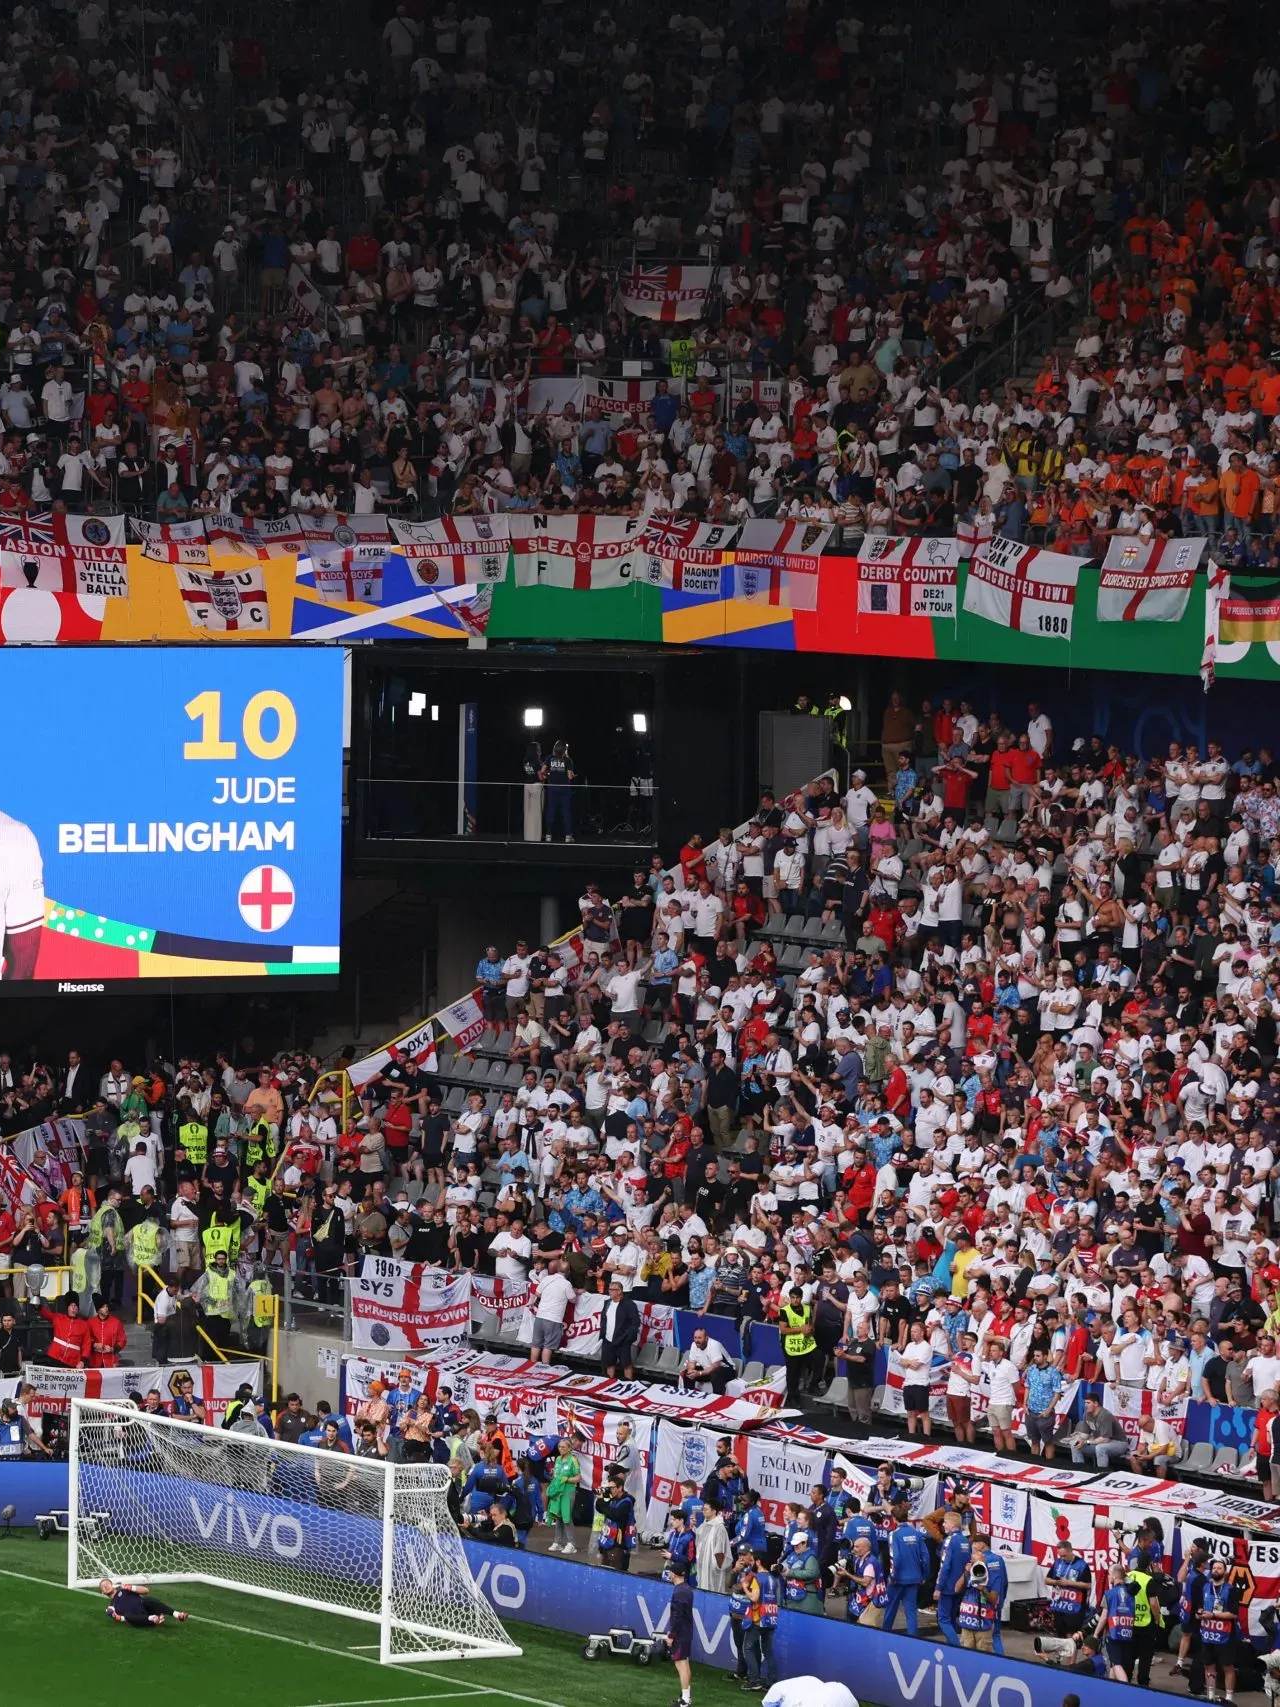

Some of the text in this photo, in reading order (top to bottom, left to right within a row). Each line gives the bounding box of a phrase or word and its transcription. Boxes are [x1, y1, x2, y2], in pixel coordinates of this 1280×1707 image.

[589, 397, 651, 414] MACCLESF
[265, 520, 291, 533] 2024
[534, 514, 638, 533] N F
[5, 537, 124, 562] ASTON VILLA
[359, 548, 386, 557] HYDE
[415, 544, 439, 557] WHO
[441, 542, 473, 555] DARES
[528, 538, 574, 555] SLEA
[647, 539, 715, 563] PLYMOUTH
[1008, 543, 1023, 557] TO
[83, 562, 120, 574] VILLA
[737, 552, 816, 571] MAIDSTONE UNITED
[320, 570, 374, 580] KIDDY BOYS
[537, 561, 631, 578] F C
[684, 566, 720, 578] MAGNUM
[861, 565, 954, 583] DERBY COUNTY
[80, 572, 127, 585] STELLA
[189, 573, 253, 586] N U
[684, 578, 718, 590] SOCIETY
[974, 560, 1069, 602] DORCHESTER TOWN
[1102, 572, 1176, 588] DORCHESTER SPORTS
[86, 584, 123, 596] BALTI
[923, 588, 945, 599] DE21
[914, 601, 953, 612] ON TOUR
[250, 608, 264, 622] C
[1038, 615, 1068, 634] 1880
[184, 690, 297, 760] 10
[212, 777, 296, 804] JUDE
[58, 821, 295, 854] BELLINGHAM
[58, 982, 105, 993] Hisense
[361, 1279, 394, 1298] SY5
[358, 1303, 468, 1324] SHREWSBURY TOWN
[31, 1374, 85, 1382] THE BORO BOYS
[58, 1382, 78, 1390] TOWN
[31, 1400, 72, 1414] MIDDLE
[504, 1424, 526, 1439] QPR
[761, 1454, 812, 1477] ENGLAND
[785, 1476, 790, 1491] I
[1215, 1494, 1273, 1516] LEICES
[188, 1491, 302, 1558] vivo
[992, 1526, 1023, 1542] MAGS
[1135, 1604, 1148, 1612] RD
[1200, 1631, 1222, 1642] -032
